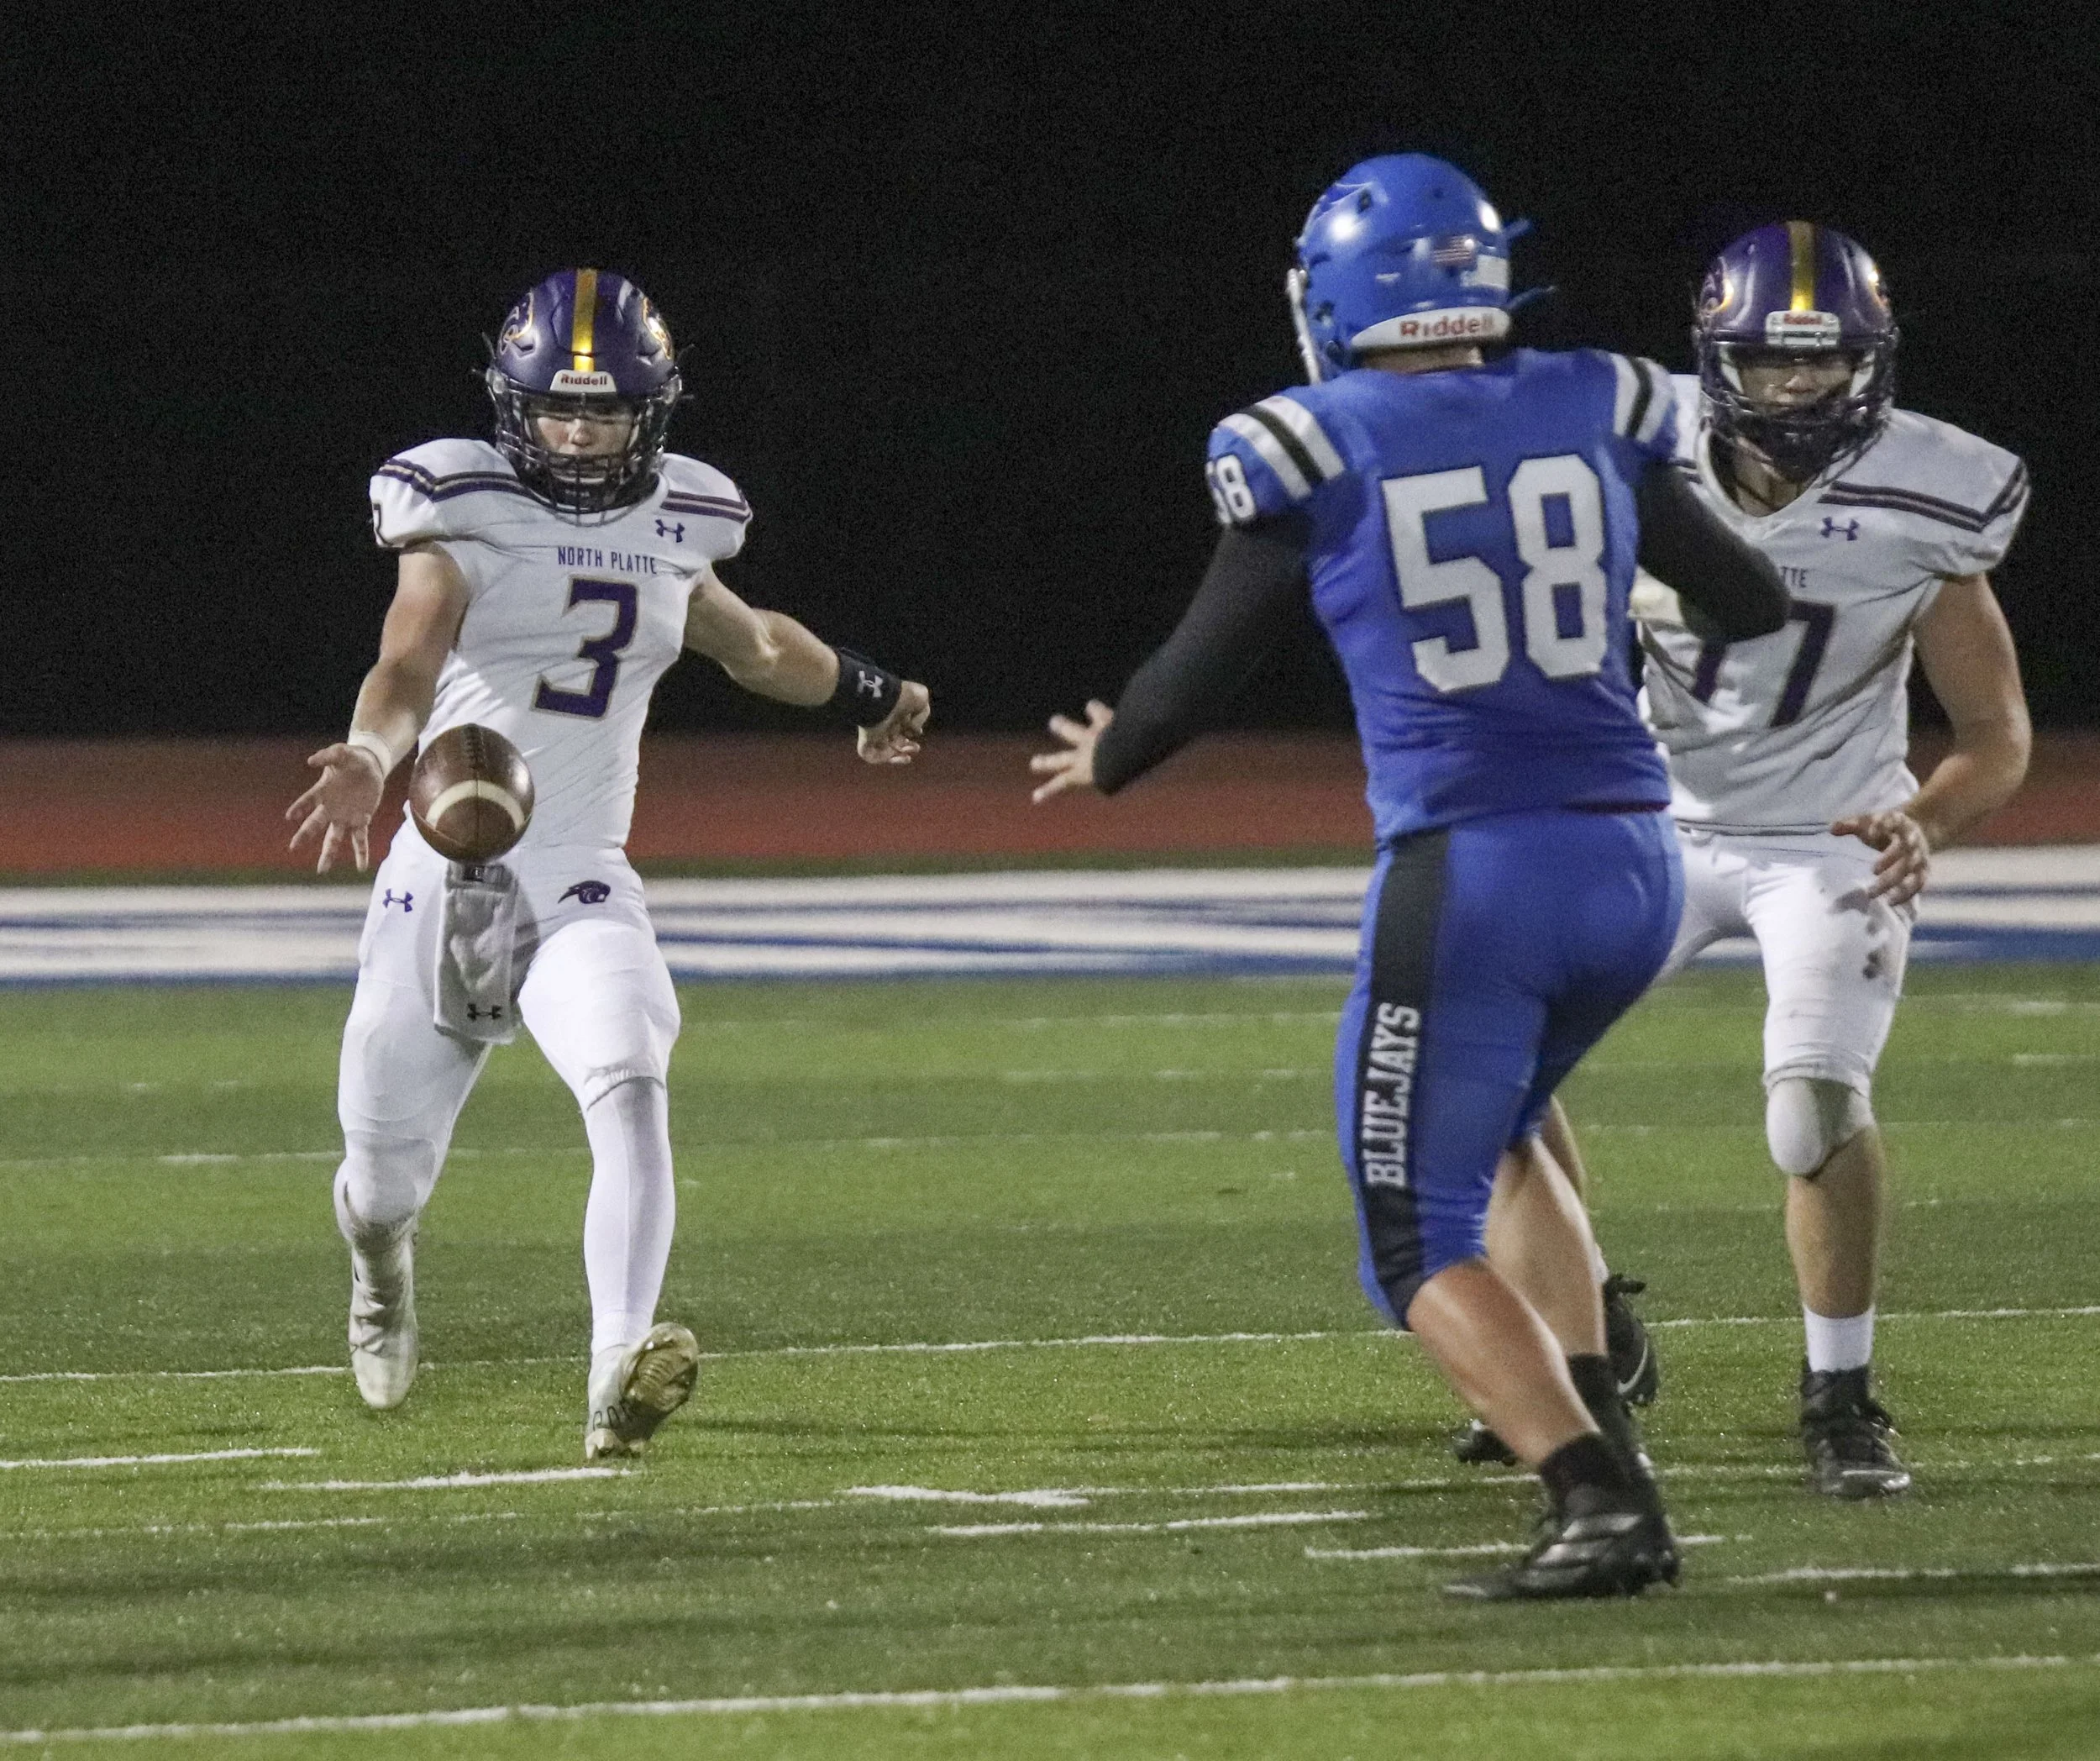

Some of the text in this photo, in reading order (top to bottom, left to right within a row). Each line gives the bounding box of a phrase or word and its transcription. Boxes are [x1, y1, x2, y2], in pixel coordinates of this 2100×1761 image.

[1399, 314, 1494, 336] Riddell
[560, 374, 608, 385] Riddell
[558, 546, 657, 575] NORTH PLATTE
[1381, 454, 1609, 693] 58
[1780, 565, 1809, 588] TTE
[532, 576, 638, 719] 3
[1362, 1002, 1420, 1187] BLUEJAYS
